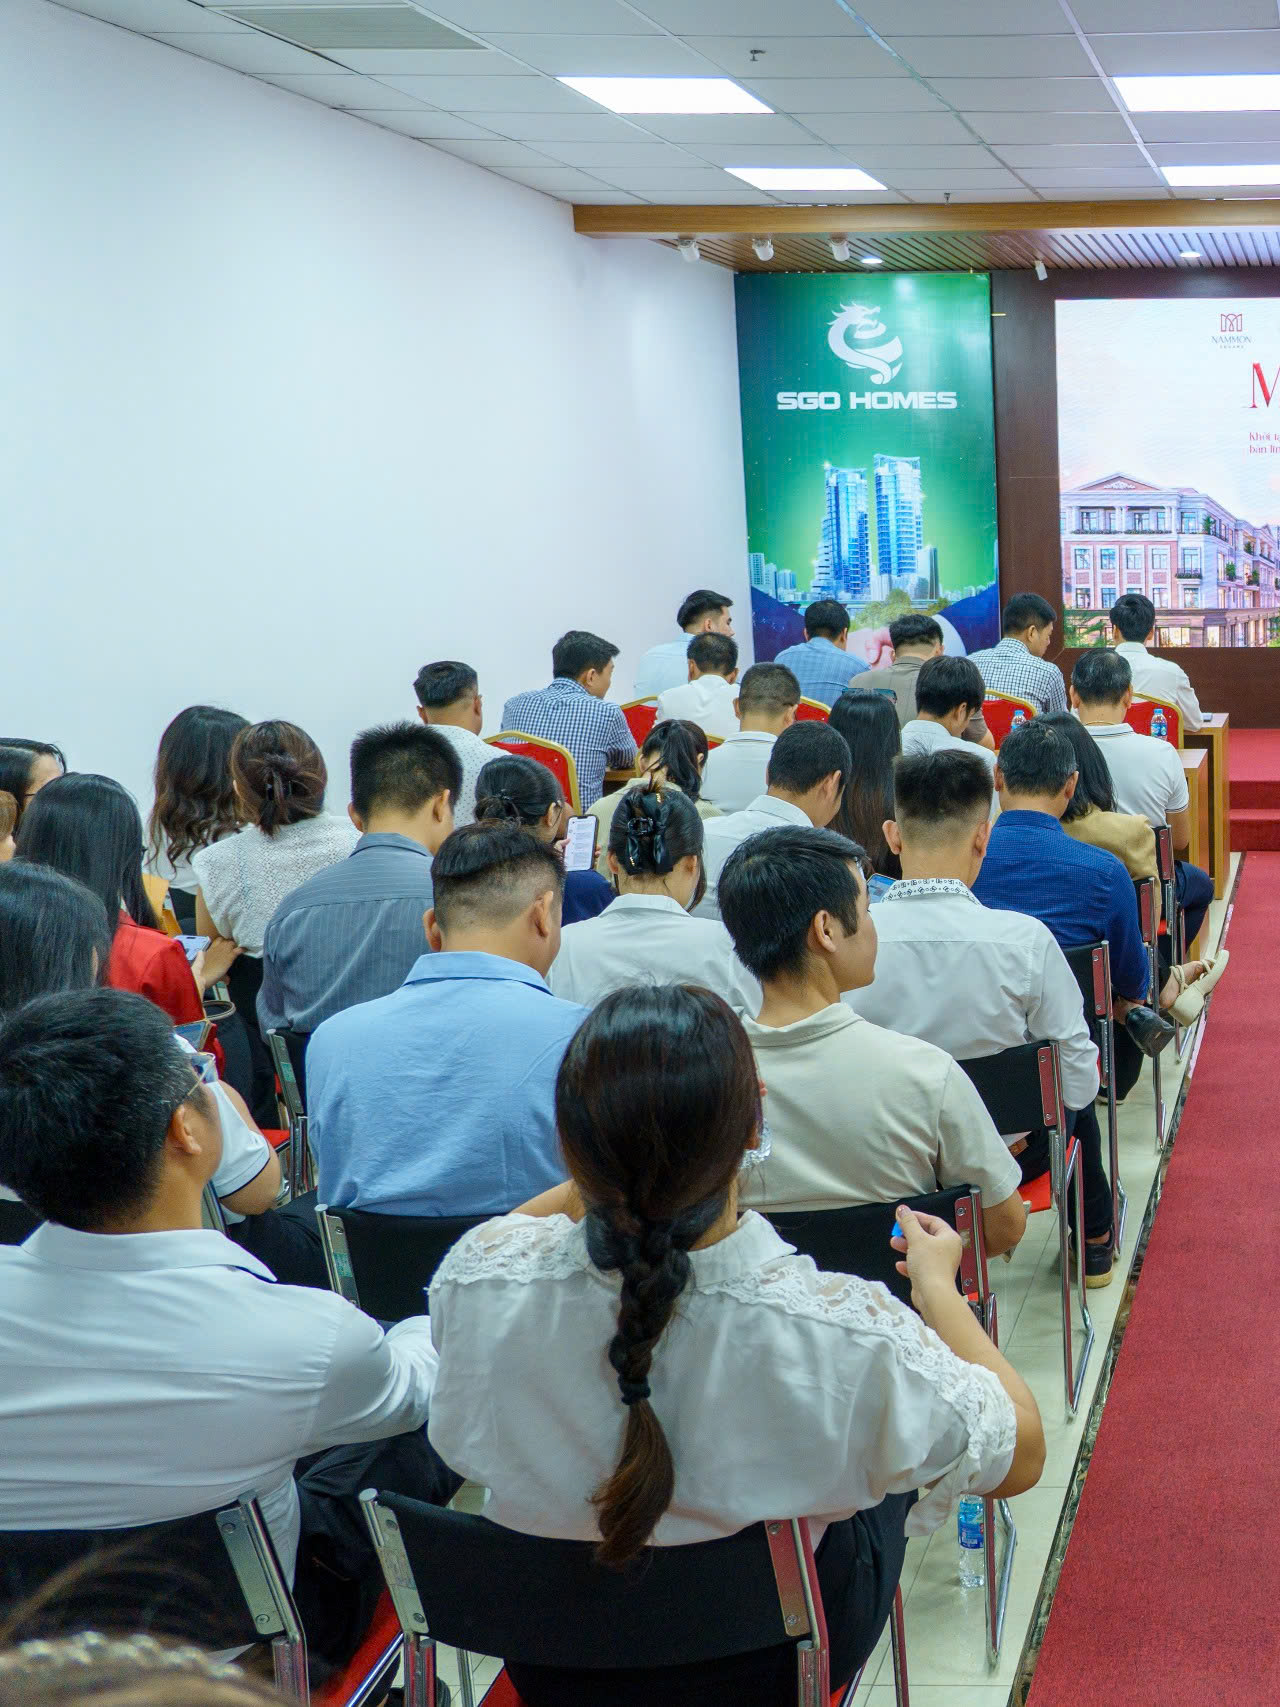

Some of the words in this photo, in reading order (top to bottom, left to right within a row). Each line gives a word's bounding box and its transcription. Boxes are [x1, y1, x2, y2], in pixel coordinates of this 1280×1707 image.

[1211, 336, 1252, 344] NAMMON
[776, 391, 841, 410] SGO
[849, 391, 958, 410] HOMES
